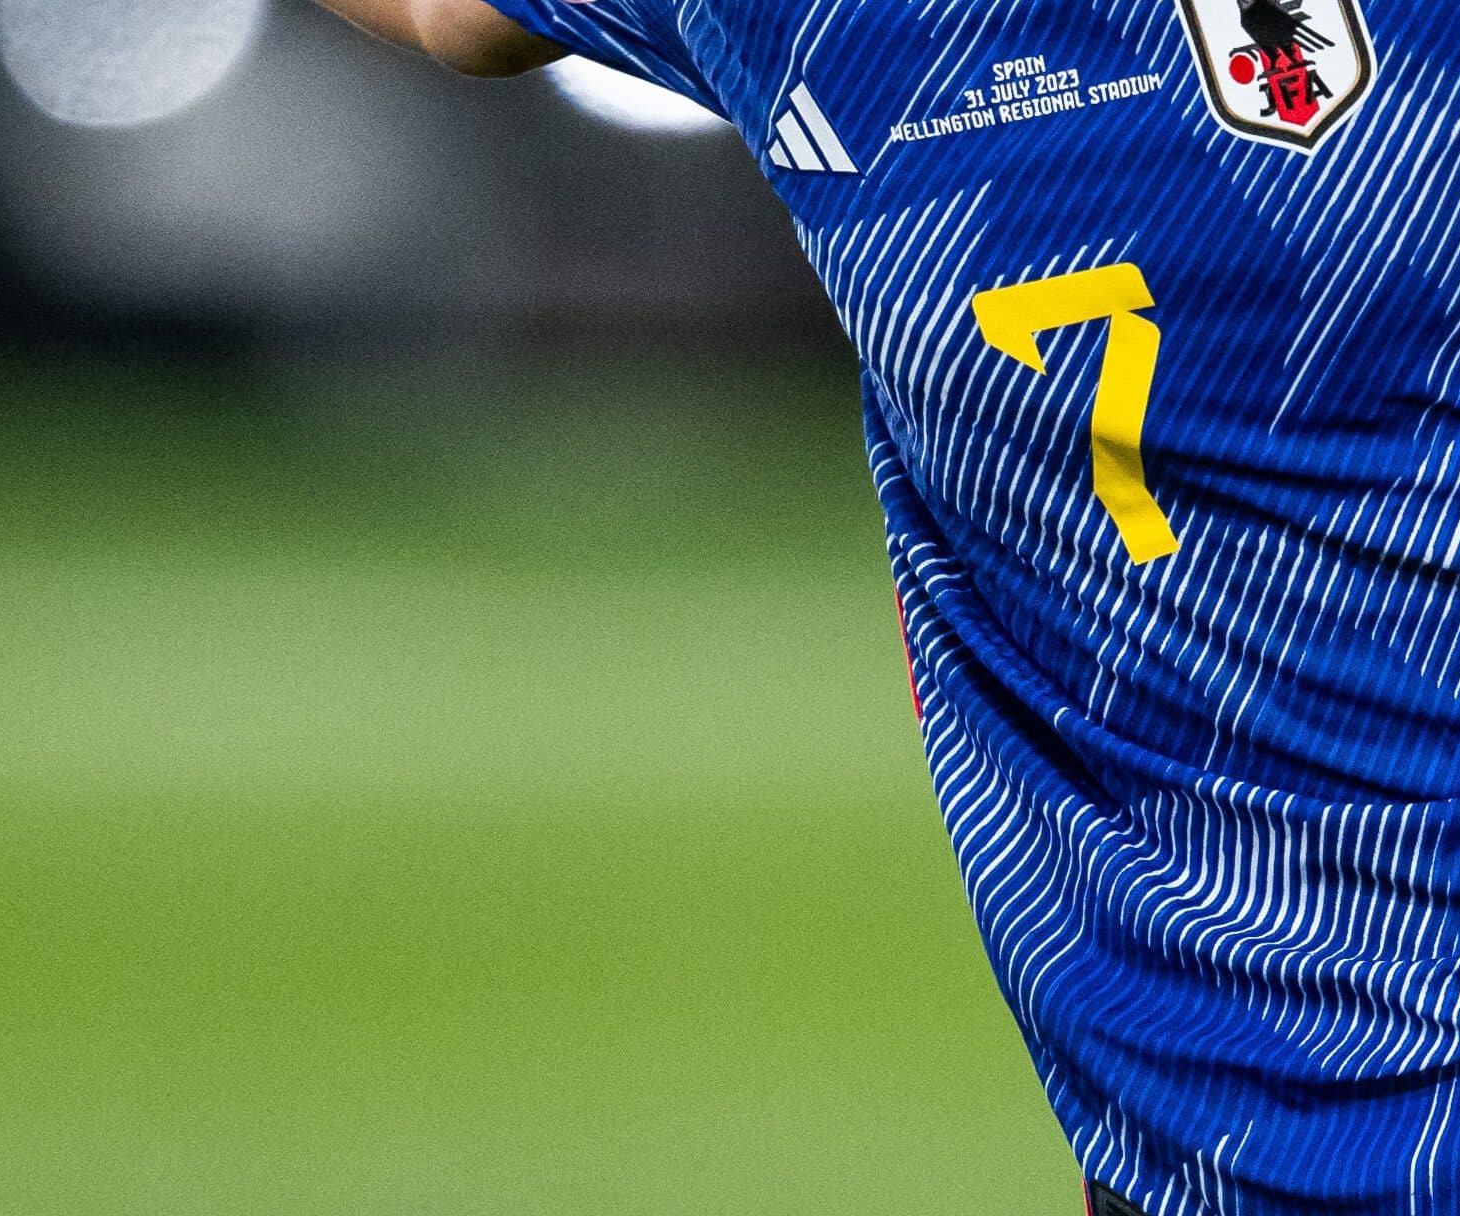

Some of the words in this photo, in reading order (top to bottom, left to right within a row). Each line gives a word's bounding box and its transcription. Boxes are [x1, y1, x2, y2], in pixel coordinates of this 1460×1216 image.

[964, 88, 986, 109] 31
[990, 79, 1030, 104] JULY
[1035, 68, 1080, 95] 2023
[992, 54, 1046, 82] SPAIN
[1258, 68, 1334, 118] JFA
[890, 107, 996, 143] WELLINGTON
[999, 89, 1086, 124] REGIONAL
[1088, 72, 1162, 105] STADIUM
[972, 262, 1180, 566] 7
